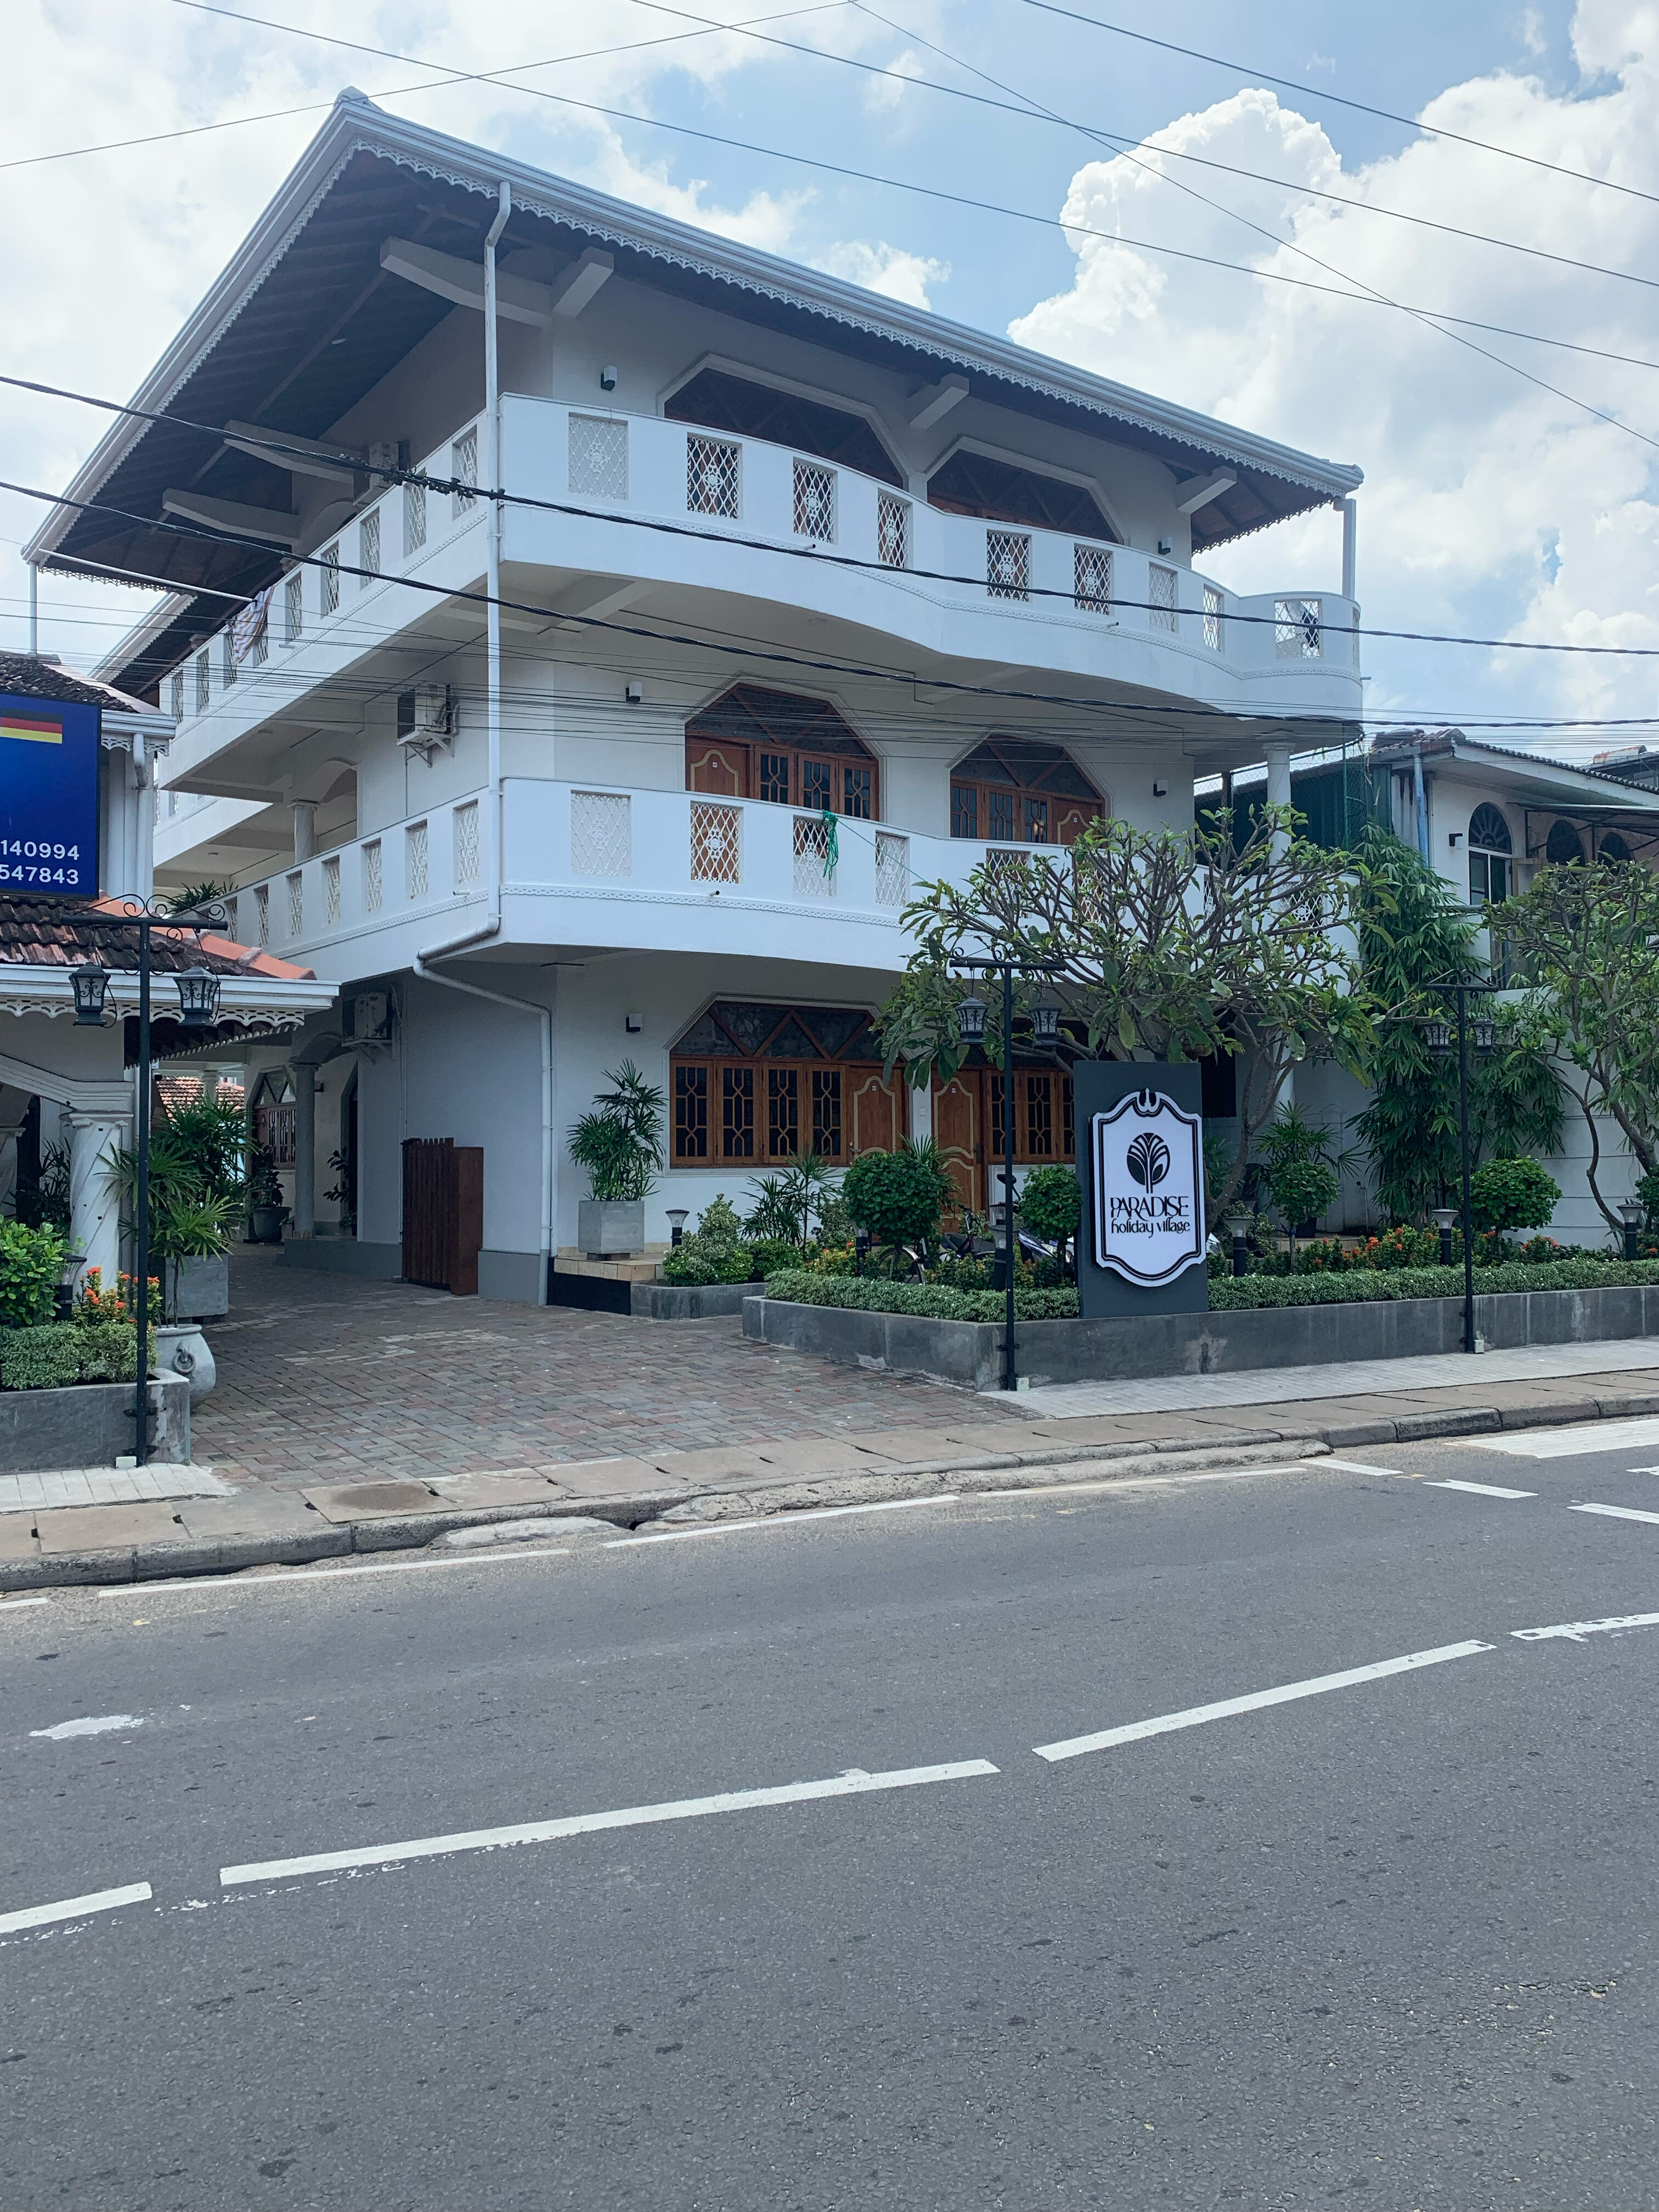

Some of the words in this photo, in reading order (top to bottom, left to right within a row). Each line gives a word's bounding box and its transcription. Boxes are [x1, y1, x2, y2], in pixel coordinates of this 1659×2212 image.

[0, 839, 80, 860] 140994
[0, 864, 79, 884] 547843
[1110, 1195, 1190, 1221] PARADISE
[1111, 1217, 1154, 1238] holiday
[1156, 1216, 1190, 1234] village
